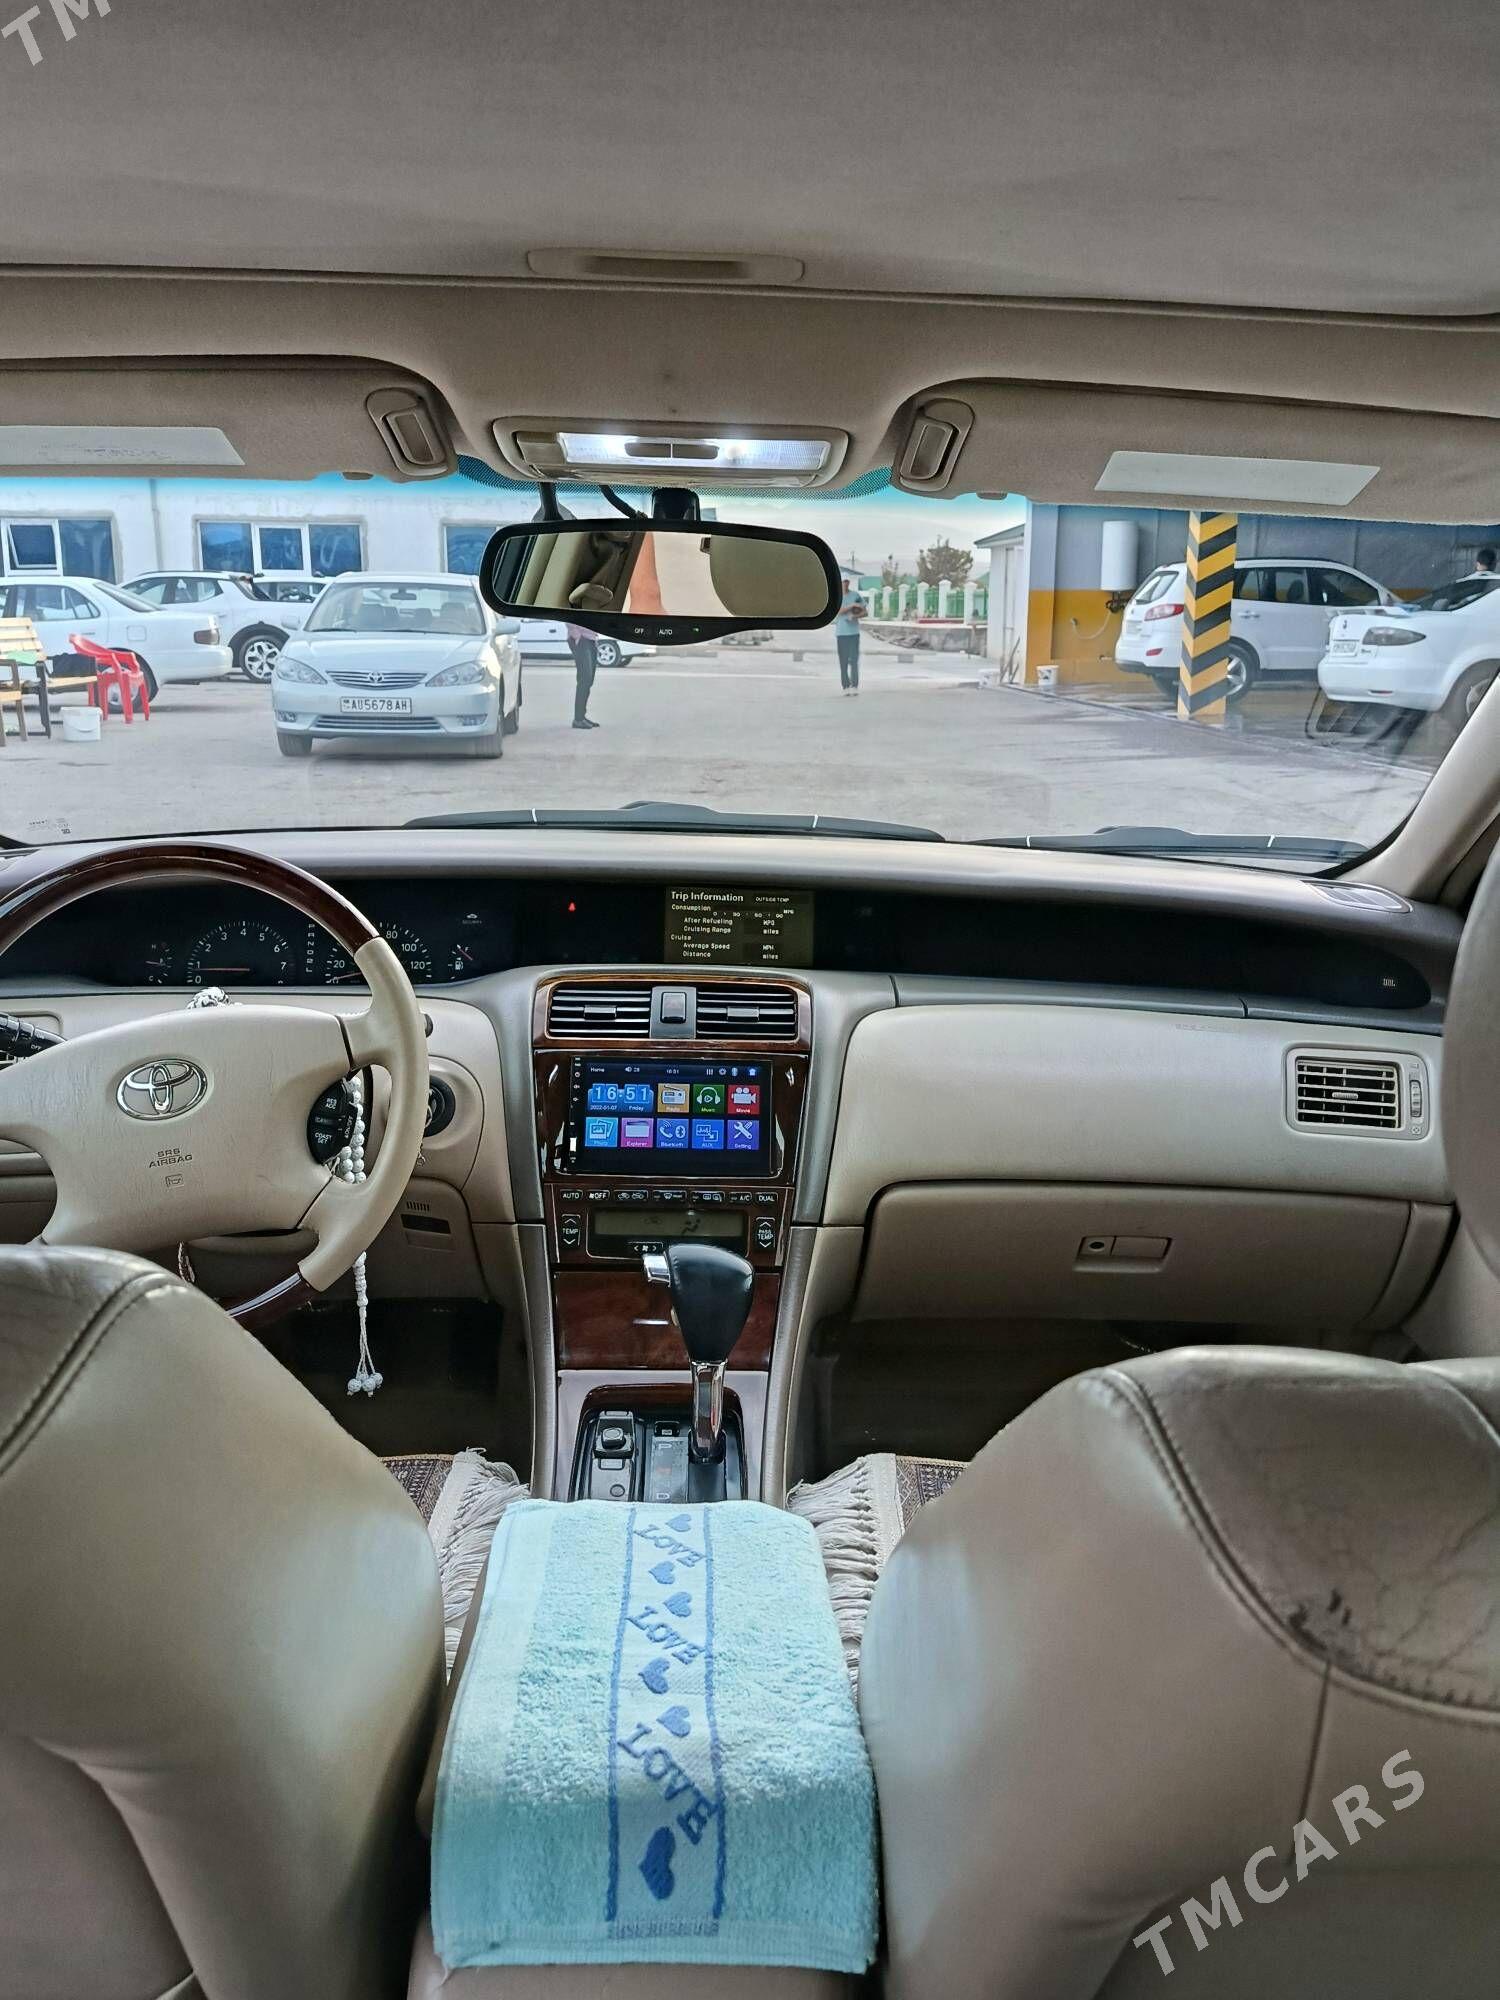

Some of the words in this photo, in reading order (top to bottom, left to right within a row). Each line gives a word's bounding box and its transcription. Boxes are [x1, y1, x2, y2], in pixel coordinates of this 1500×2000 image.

[671, 891, 689, 901] Trip
[691, 892, 744, 902] Information
[671, 904, 712, 912] Consumption
[221, 932, 228, 941] 3
[240, 928, 247, 936] 4
[386, 931, 398, 939] 80
[259, 933, 265, 941] 5
[205, 943, 212, 952] 2
[273, 944, 280, 953] 6
[401, 943, 417, 952] 100
[280, 961, 287, 970] 7
[332, 960, 345, 968] 20
[410, 961, 425, 970] 120
[194, 975, 202, 984] 0
[149, 1154, 193, 1168] AIRBAG
[626, 1606, 706, 1665] LOVE
[617, 1722, 718, 1845] LOVE
